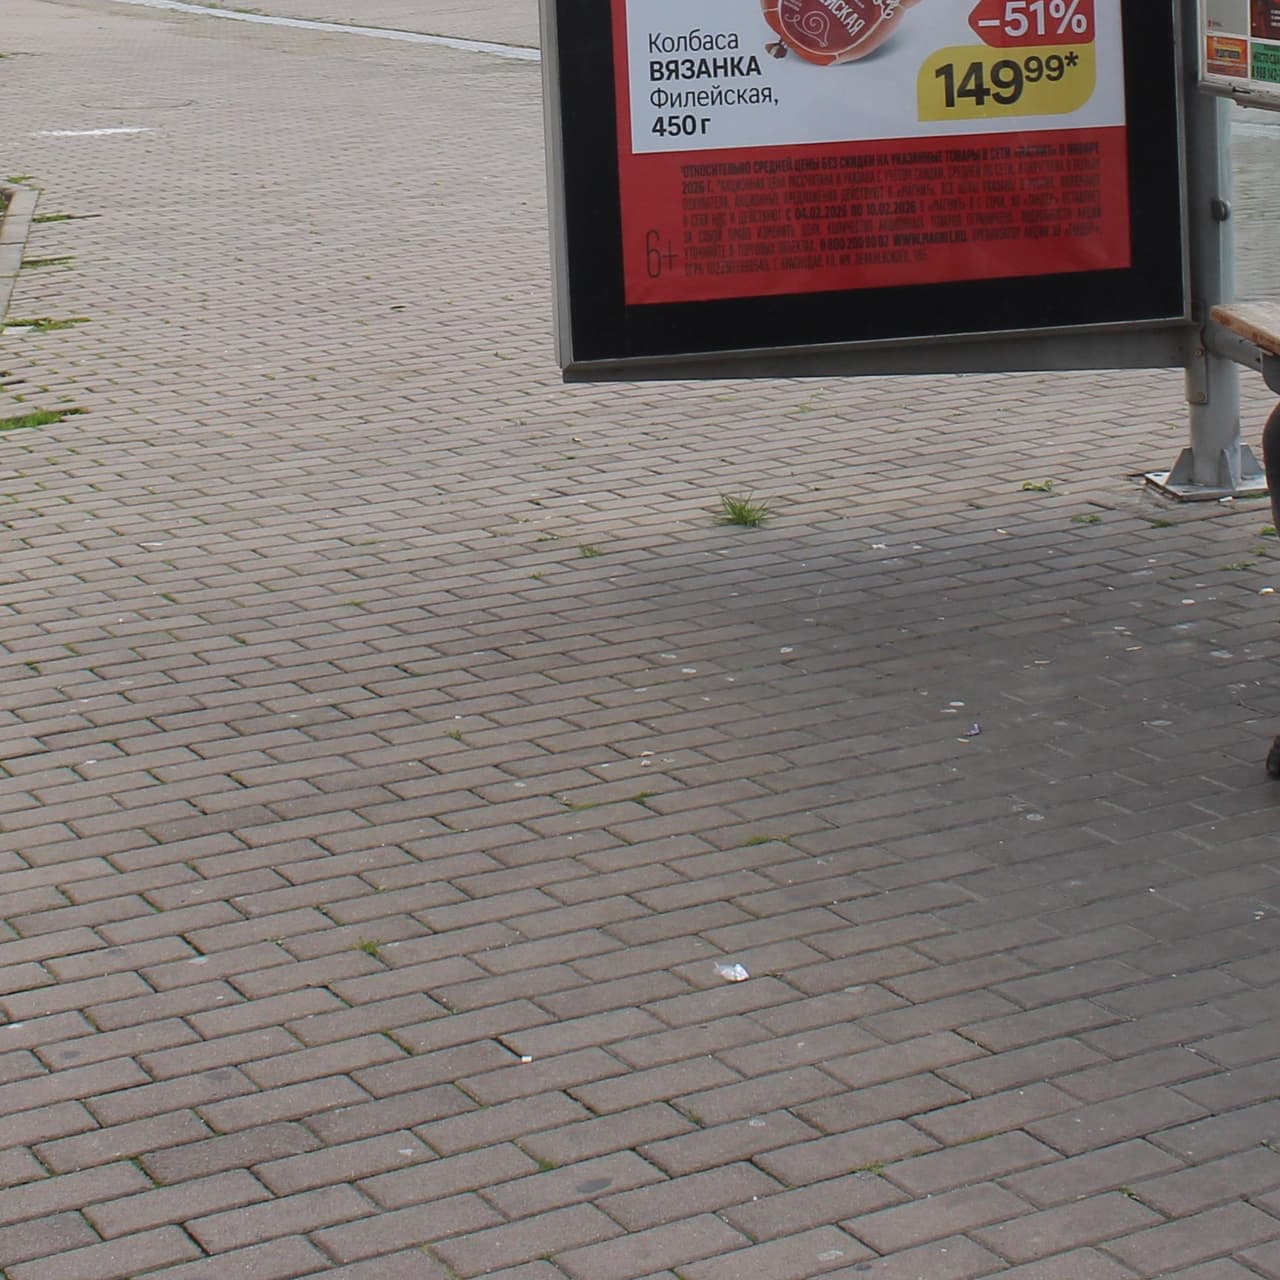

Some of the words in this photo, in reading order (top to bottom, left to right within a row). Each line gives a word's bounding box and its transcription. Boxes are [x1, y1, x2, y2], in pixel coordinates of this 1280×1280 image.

[648, 28, 739, 54] Колбаса
[649, 55, 762, 81] ВЯЗАНКА
[650, 85, 779, 109] Филейская,
[651, 114, 697, 137] 450
[646, 229, 679, 278] 6+
